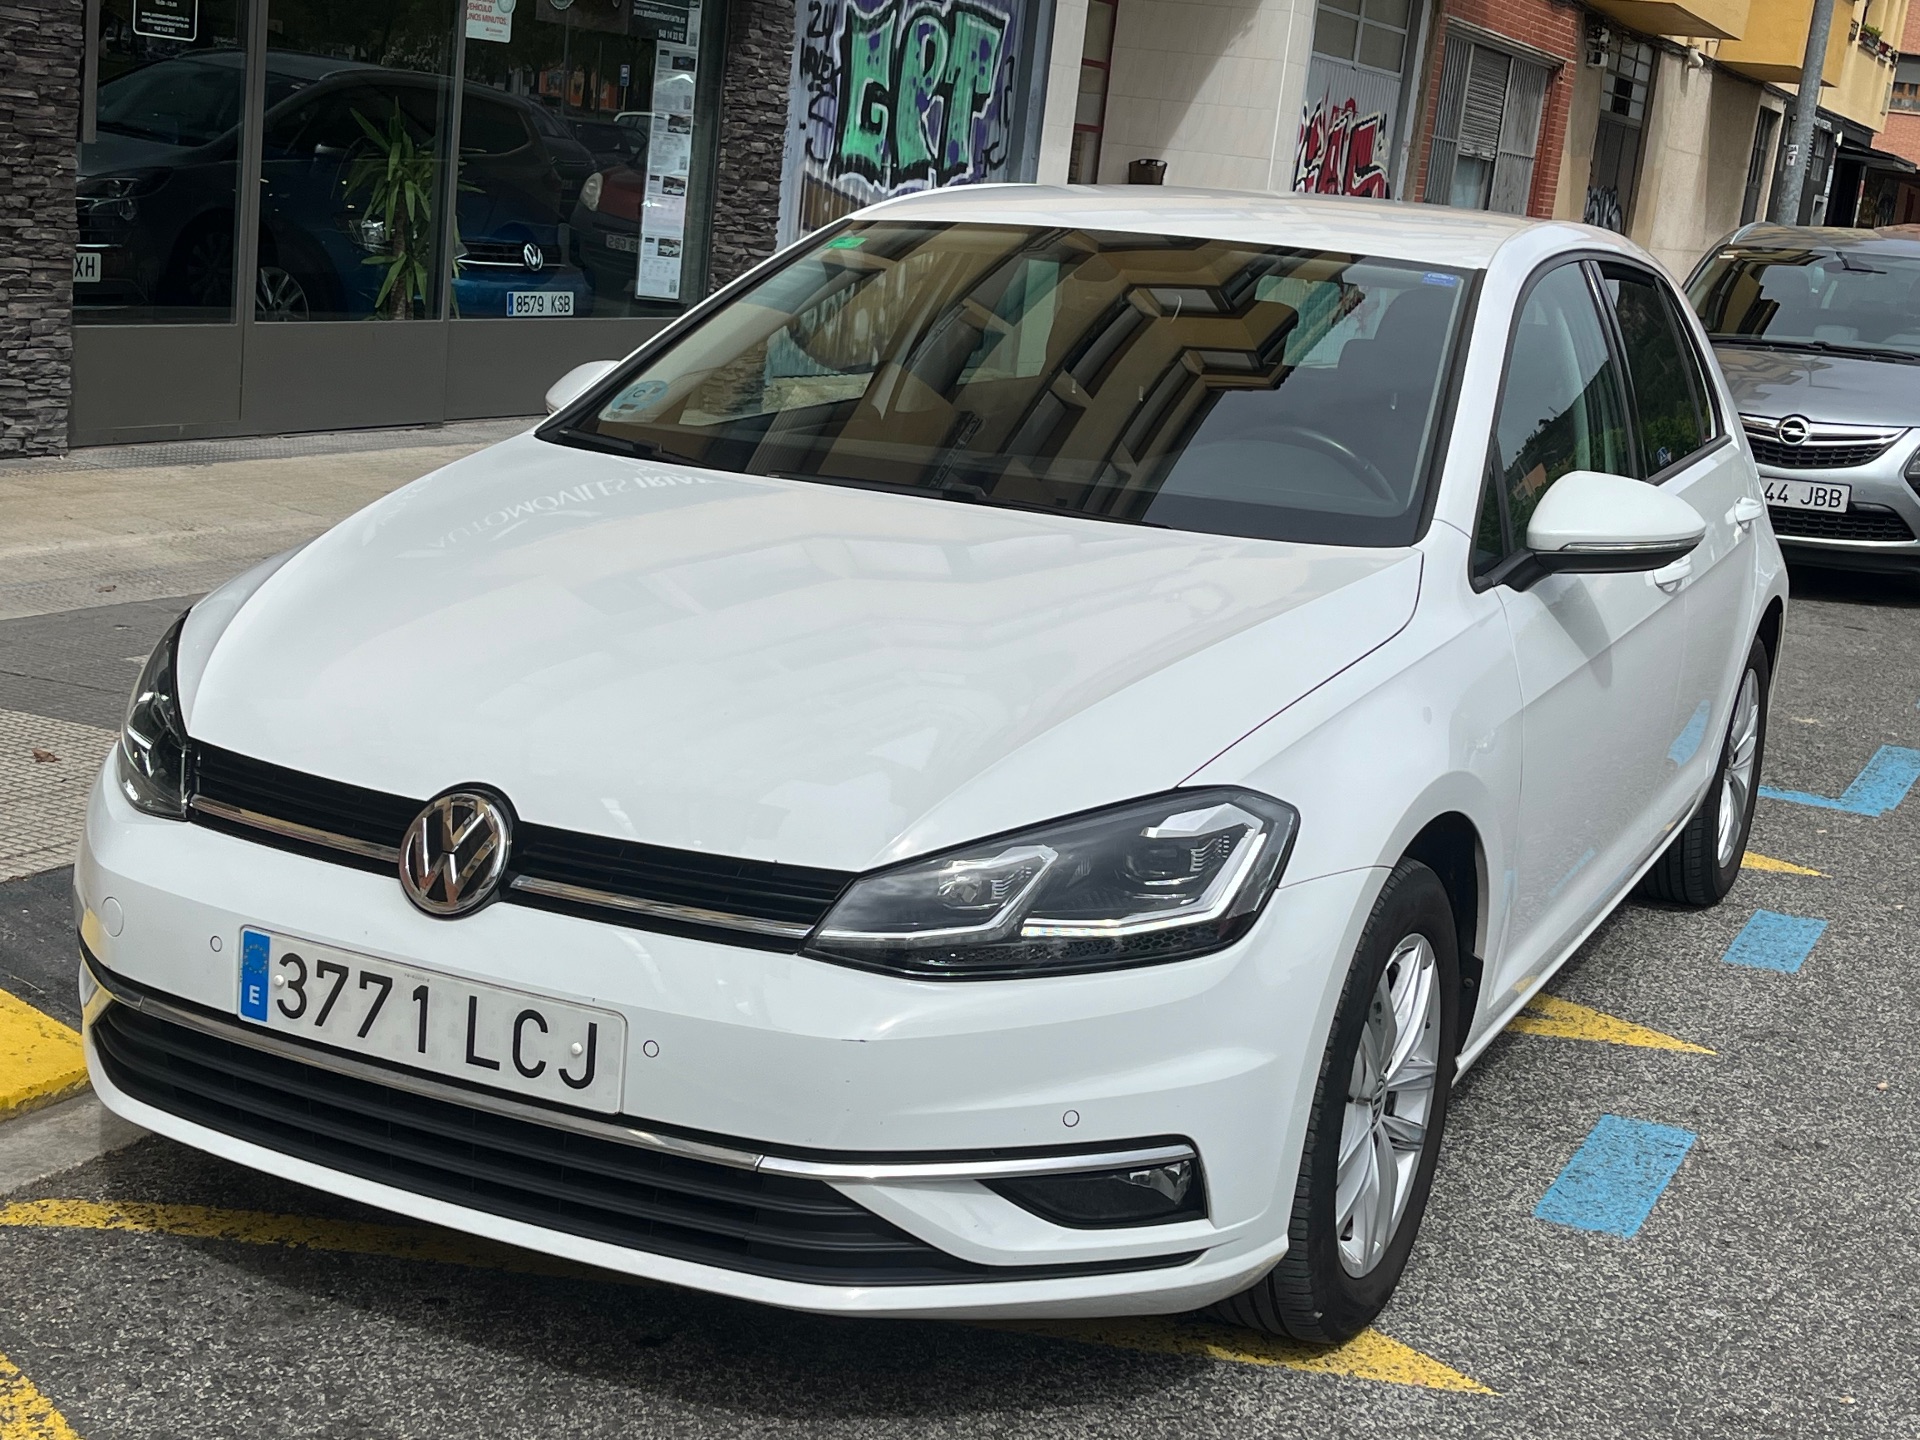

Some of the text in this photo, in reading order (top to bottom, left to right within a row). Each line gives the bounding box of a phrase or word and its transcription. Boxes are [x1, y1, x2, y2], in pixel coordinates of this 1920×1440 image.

[516, 295, 571, 313] 8579 KSB
[1800, 486, 1842, 508] JBB
[249, 984, 260, 1005] E
[276, 952, 598, 1090] 3771 LCJ
